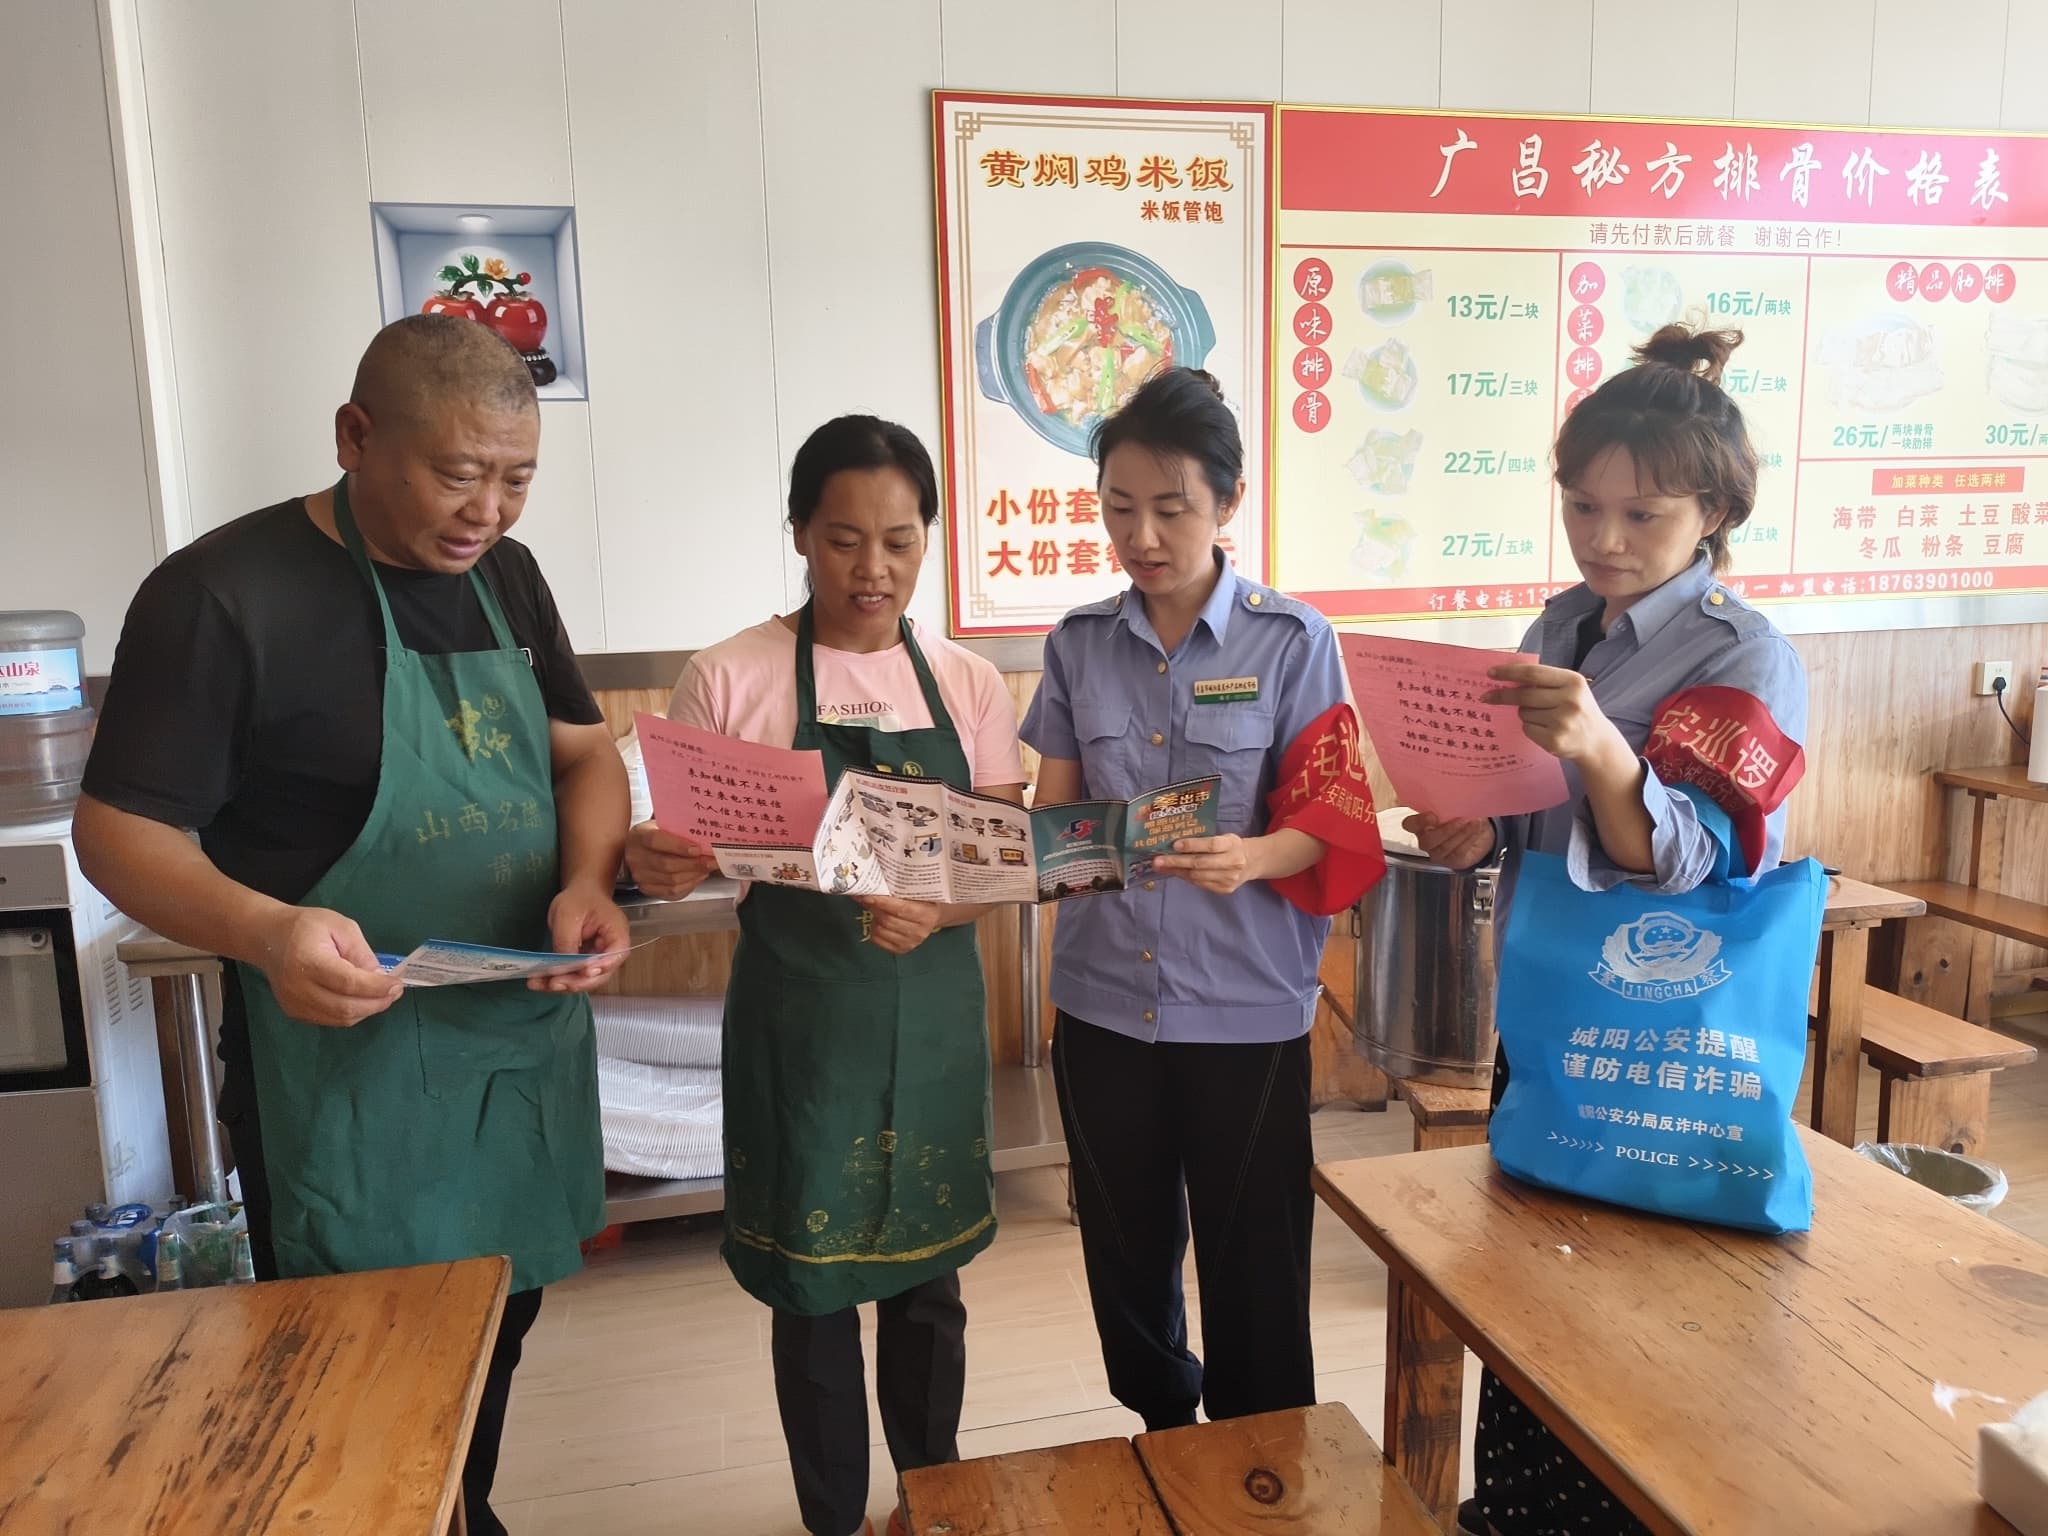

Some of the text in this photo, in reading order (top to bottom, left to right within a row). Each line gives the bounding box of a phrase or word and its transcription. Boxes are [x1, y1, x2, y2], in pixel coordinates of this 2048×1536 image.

[979, 150, 1234, 192] 黄焖鸡米饭
[1428, 127, 2010, 211] 广昌秘方排骨价格表
[1140, 200, 1225, 224] 米饭管饱
[1589, 222, 1736, 248] 请先付款后就餐
[1891, 265, 2009, 299] 精品肋排
[1447, 294, 1539, 322] 13元/二块
[1706, 291, 1792, 317] 16元/两块
[1297, 264, 1329, 428] 原味排骨
[1446, 372, 1538, 398] 17元/三块
[1722, 369, 1788, 394] 元/三块
[1443, 450, 1537, 475] 22元/四块
[1832, 501, 2048, 530] 海带 白菜 土豆 酸菜
[1441, 533, 1536, 558] 27元/五块
[1858, 532, 2025, 560] 冬瓜 粉条 豆腐
[1396, 680, 1481, 703] 未知链接不点
[816, 700, 895, 716] FASHION
[1624, 983, 1694, 1000] JINGCHA
[1568, 1026, 1761, 1064] 城阳公安提醒
[1561, 1051, 1763, 1101] 谨防电信诈骗
[1615, 1145, 1680, 1167] POLICE
